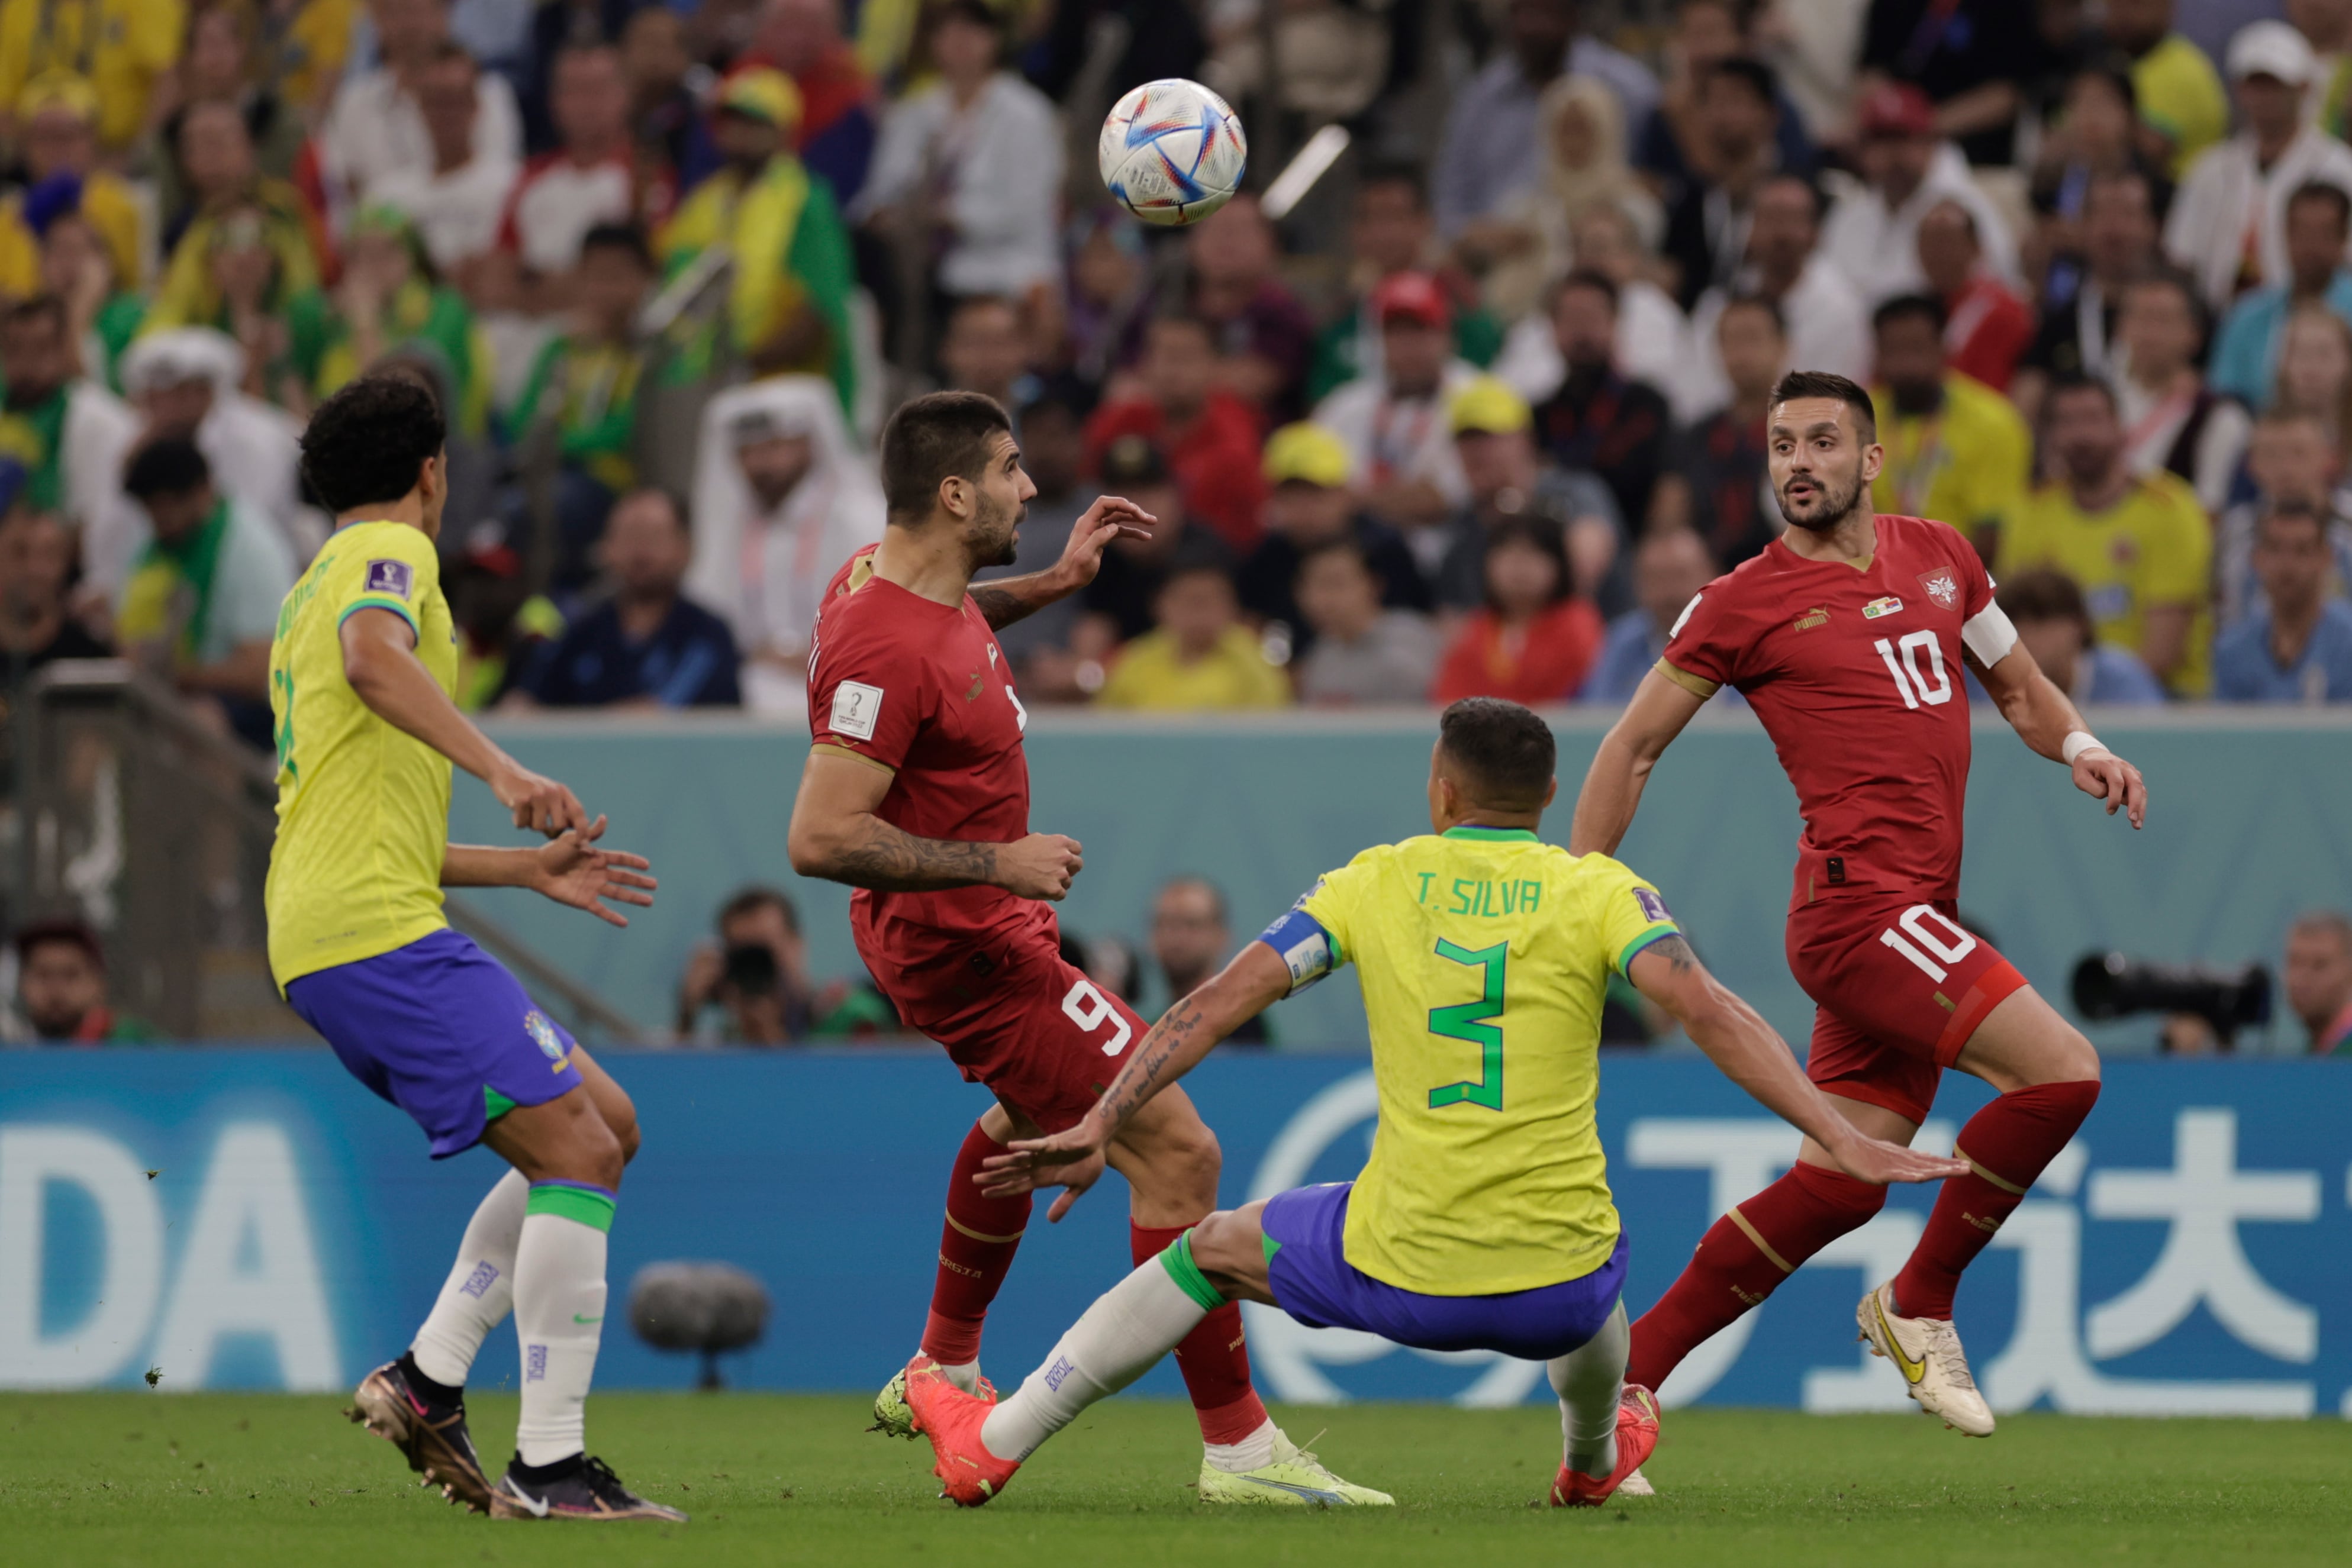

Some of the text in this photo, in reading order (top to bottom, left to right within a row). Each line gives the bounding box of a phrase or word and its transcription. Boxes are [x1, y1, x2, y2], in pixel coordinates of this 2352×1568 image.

[1793, 615, 1827, 632] PUMA
[1874, 630, 1952, 709] 10
[1417, 872, 1542, 918] T. SILVA
[1879, 904, 1977, 984] 10
[1061, 980, 1132, 1056] 9
[1428, 937, 1509, 1112] 3
[459, 1259, 500, 1299] BRASIL
[526, 1344, 547, 1383] BRASIL
[1044, 1355, 1075, 1393] BRASIL
